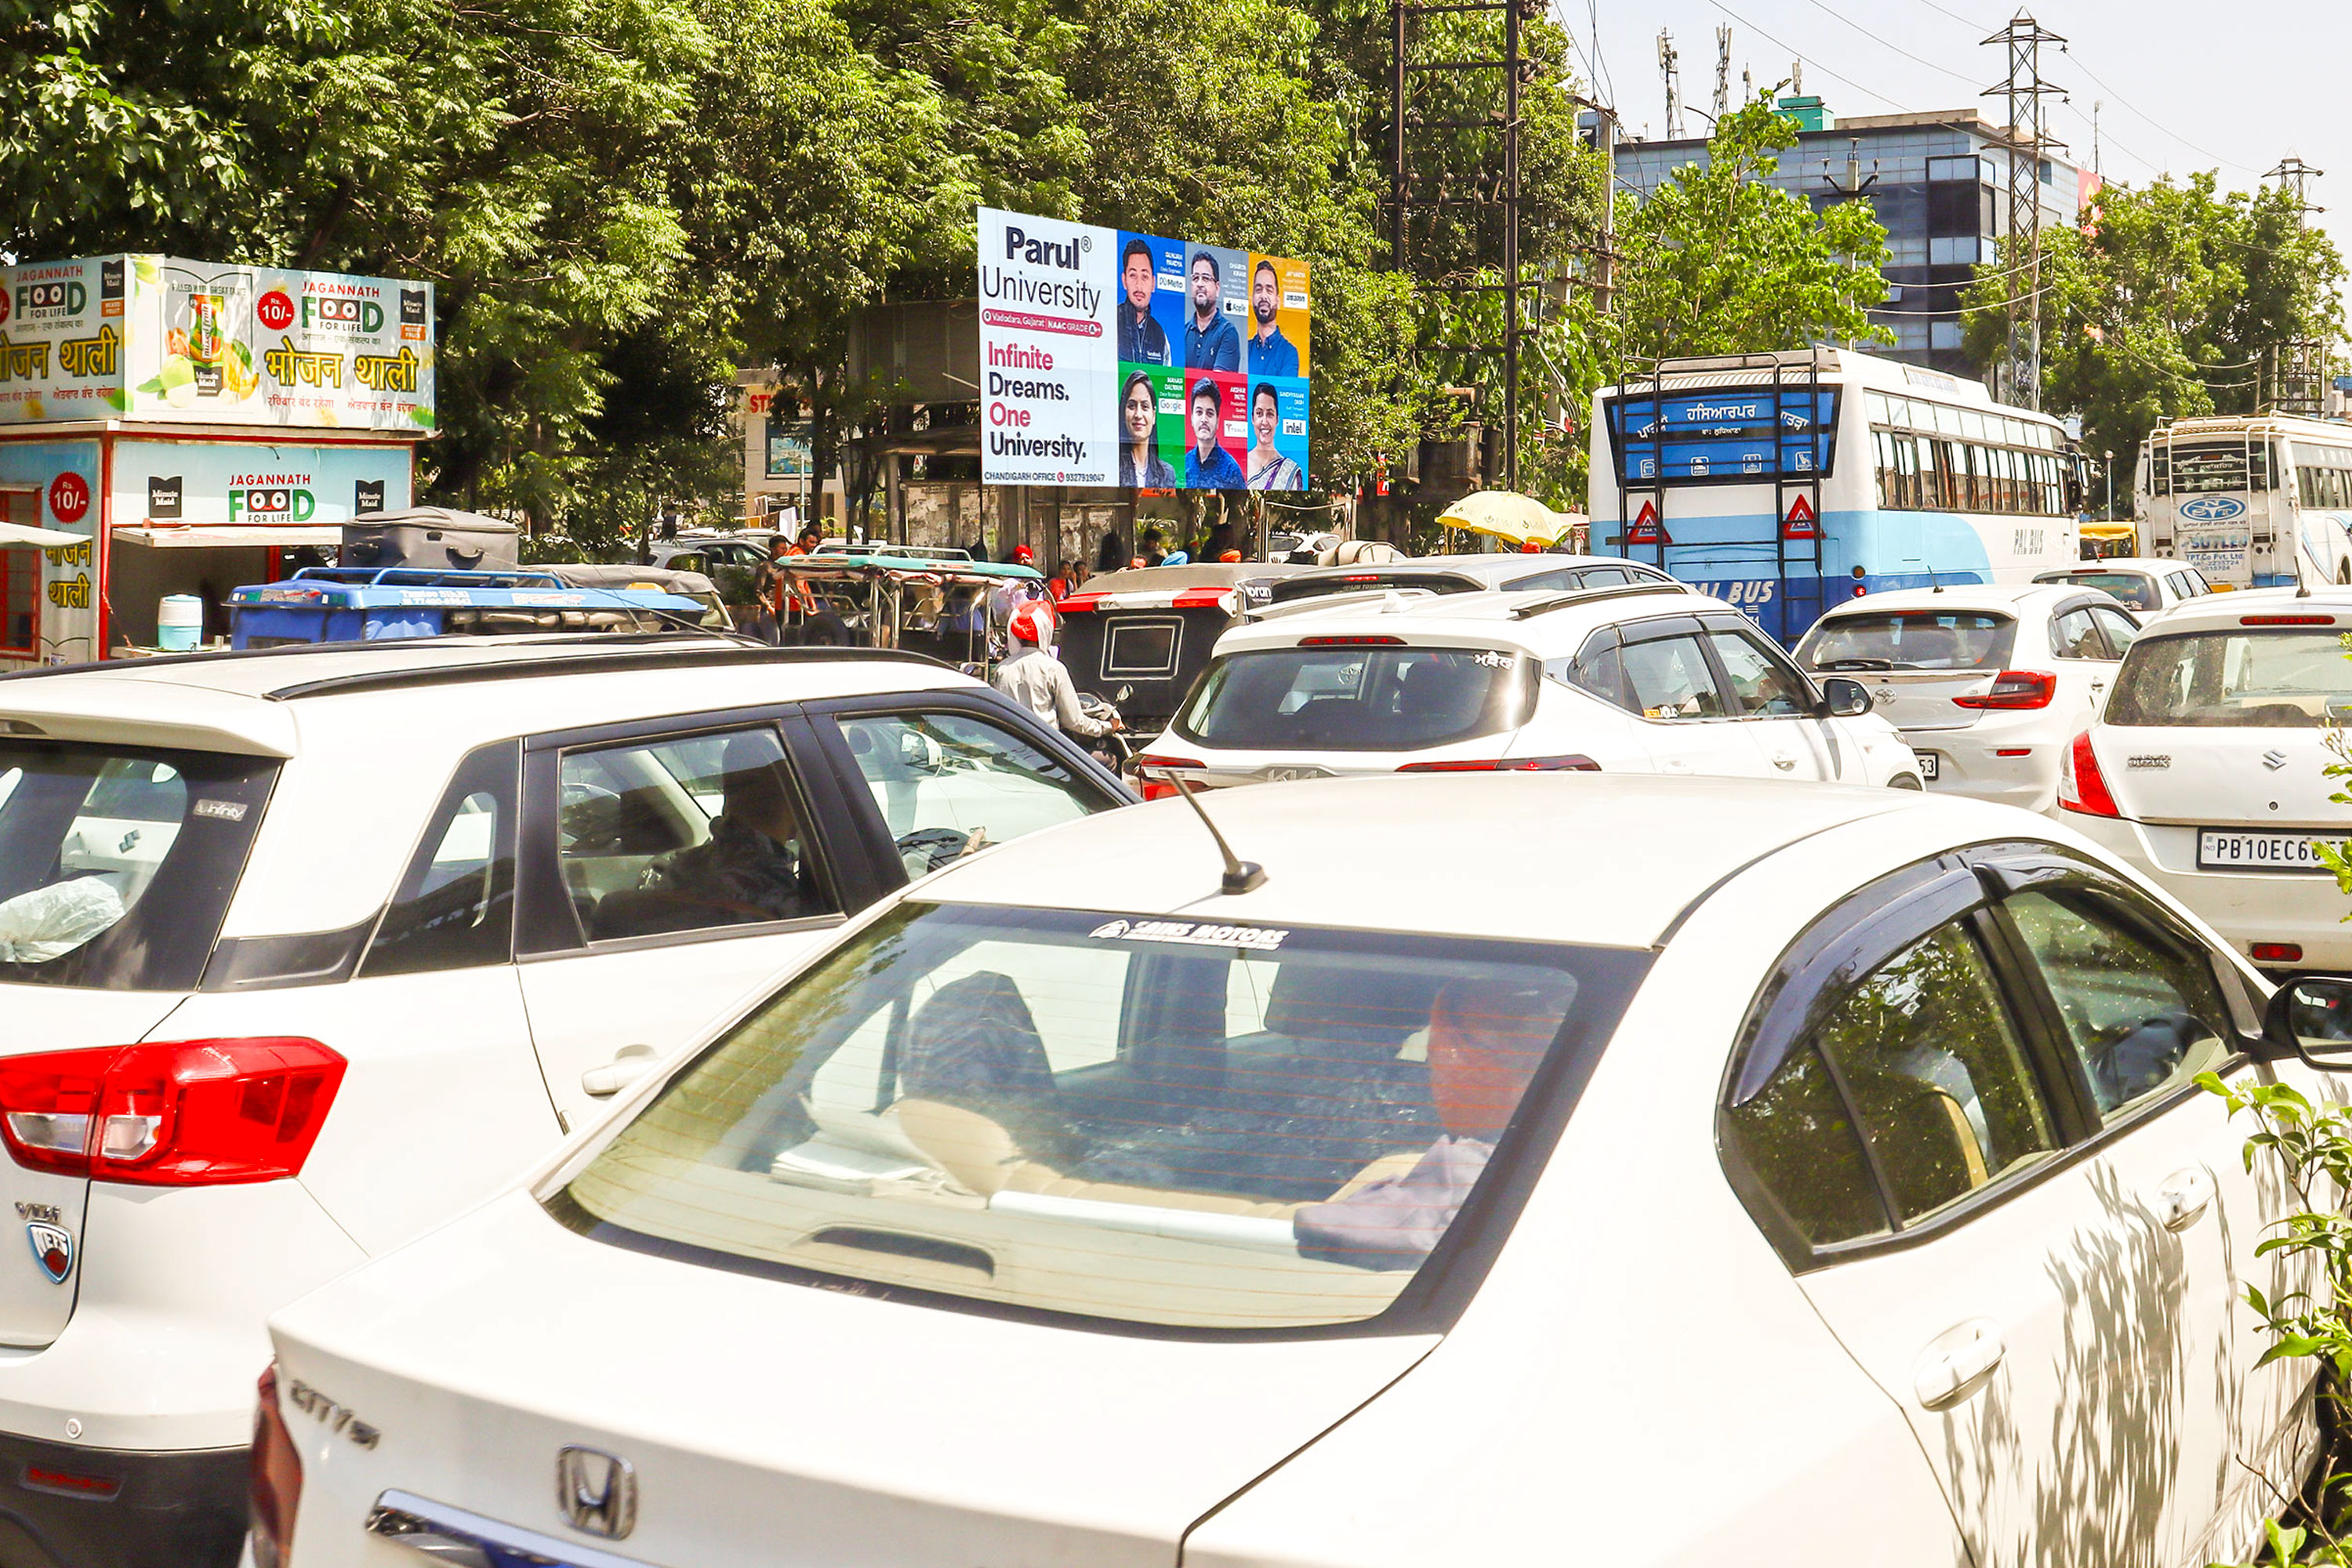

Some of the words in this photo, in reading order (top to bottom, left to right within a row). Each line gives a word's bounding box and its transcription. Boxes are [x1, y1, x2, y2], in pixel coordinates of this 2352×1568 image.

[1006, 226, 1080, 270] Parul
[16, 266, 83, 282] JAGANNATH
[302, 281, 379, 298] JAGANNATH
[1167, 278, 1183, 289] Meta
[983, 265, 1101, 319] University
[1287, 294, 1305, 303] amazon
[31, 310, 47, 318] FOR
[50, 308, 66, 318] LIFE
[262, 305, 292, 321] 10/-
[1232, 303, 1246, 313] Apple
[320, 322, 339, 331] FOR
[343, 323, 361, 332] LIFE
[1022, 317, 1045, 328] Gujarat
[1047, 320, 1066, 329] NAAC
[1067, 322, 1088, 332] GRADE
[59, 323, 118, 377] थाली
[989, 341, 1054, 371] Infinite
[265, 335, 343, 389] भोजन
[354, 346, 419, 392] थाली
[989, 372, 1069, 401] Dreams.
[989, 401, 1031, 427] One
[1286, 422, 1303, 434] intel
[990, 431, 1087, 465] University.
[229, 474, 310, 485] JAGANNATH
[984, 471, 1032, 481] CHANDIGARH
[1033, 472, 1056, 481] OFFICE
[54, 491, 86, 510] 10/-
[155, 497, 175, 506] Maid
[248, 514, 267, 523] FOR
[272, 514, 291, 522] LIFE
[48, 572, 90, 608] थाली
[1726, 581, 1775, 604] BUS
[1190, 924, 1290, 944] MOTORS
